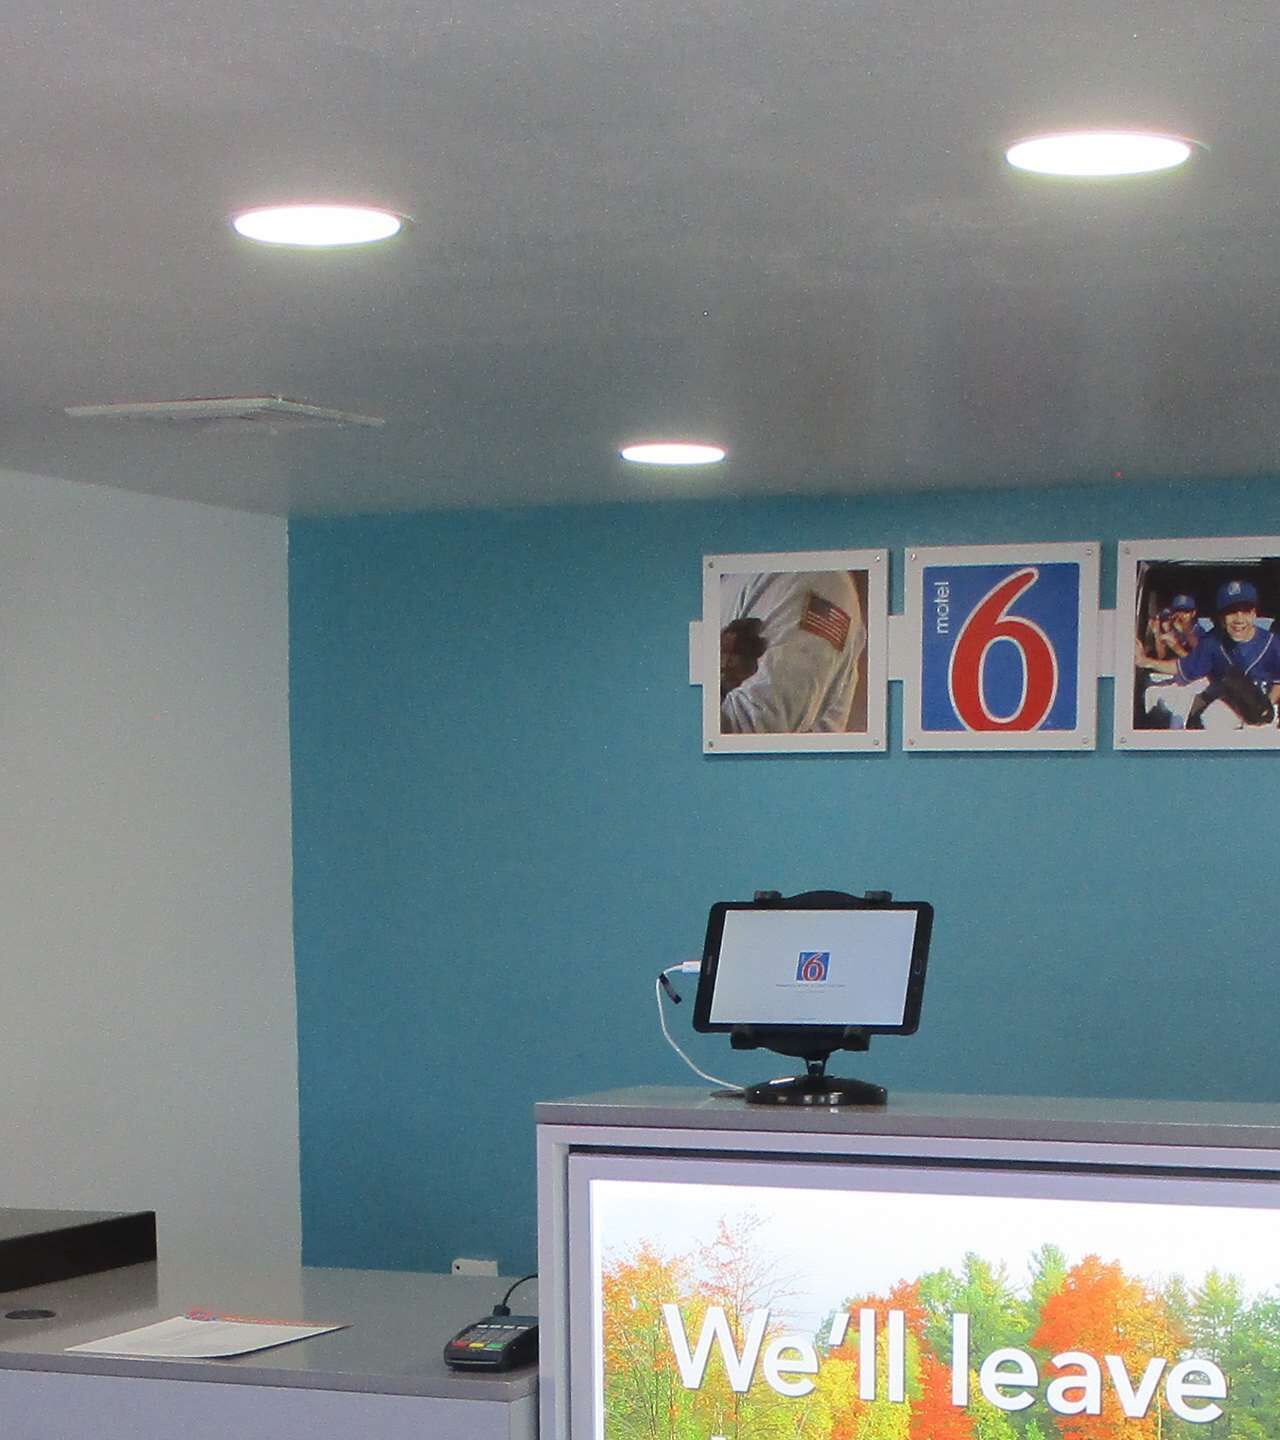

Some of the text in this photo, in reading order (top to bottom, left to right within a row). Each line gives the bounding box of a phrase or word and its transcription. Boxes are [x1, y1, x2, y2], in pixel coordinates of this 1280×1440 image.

[934, 581, 950, 634] motel
[947, 567, 1059, 733] 6
[802, 951, 825, 983] 6
[662, 1303, 1228, 1423] We'll leave
